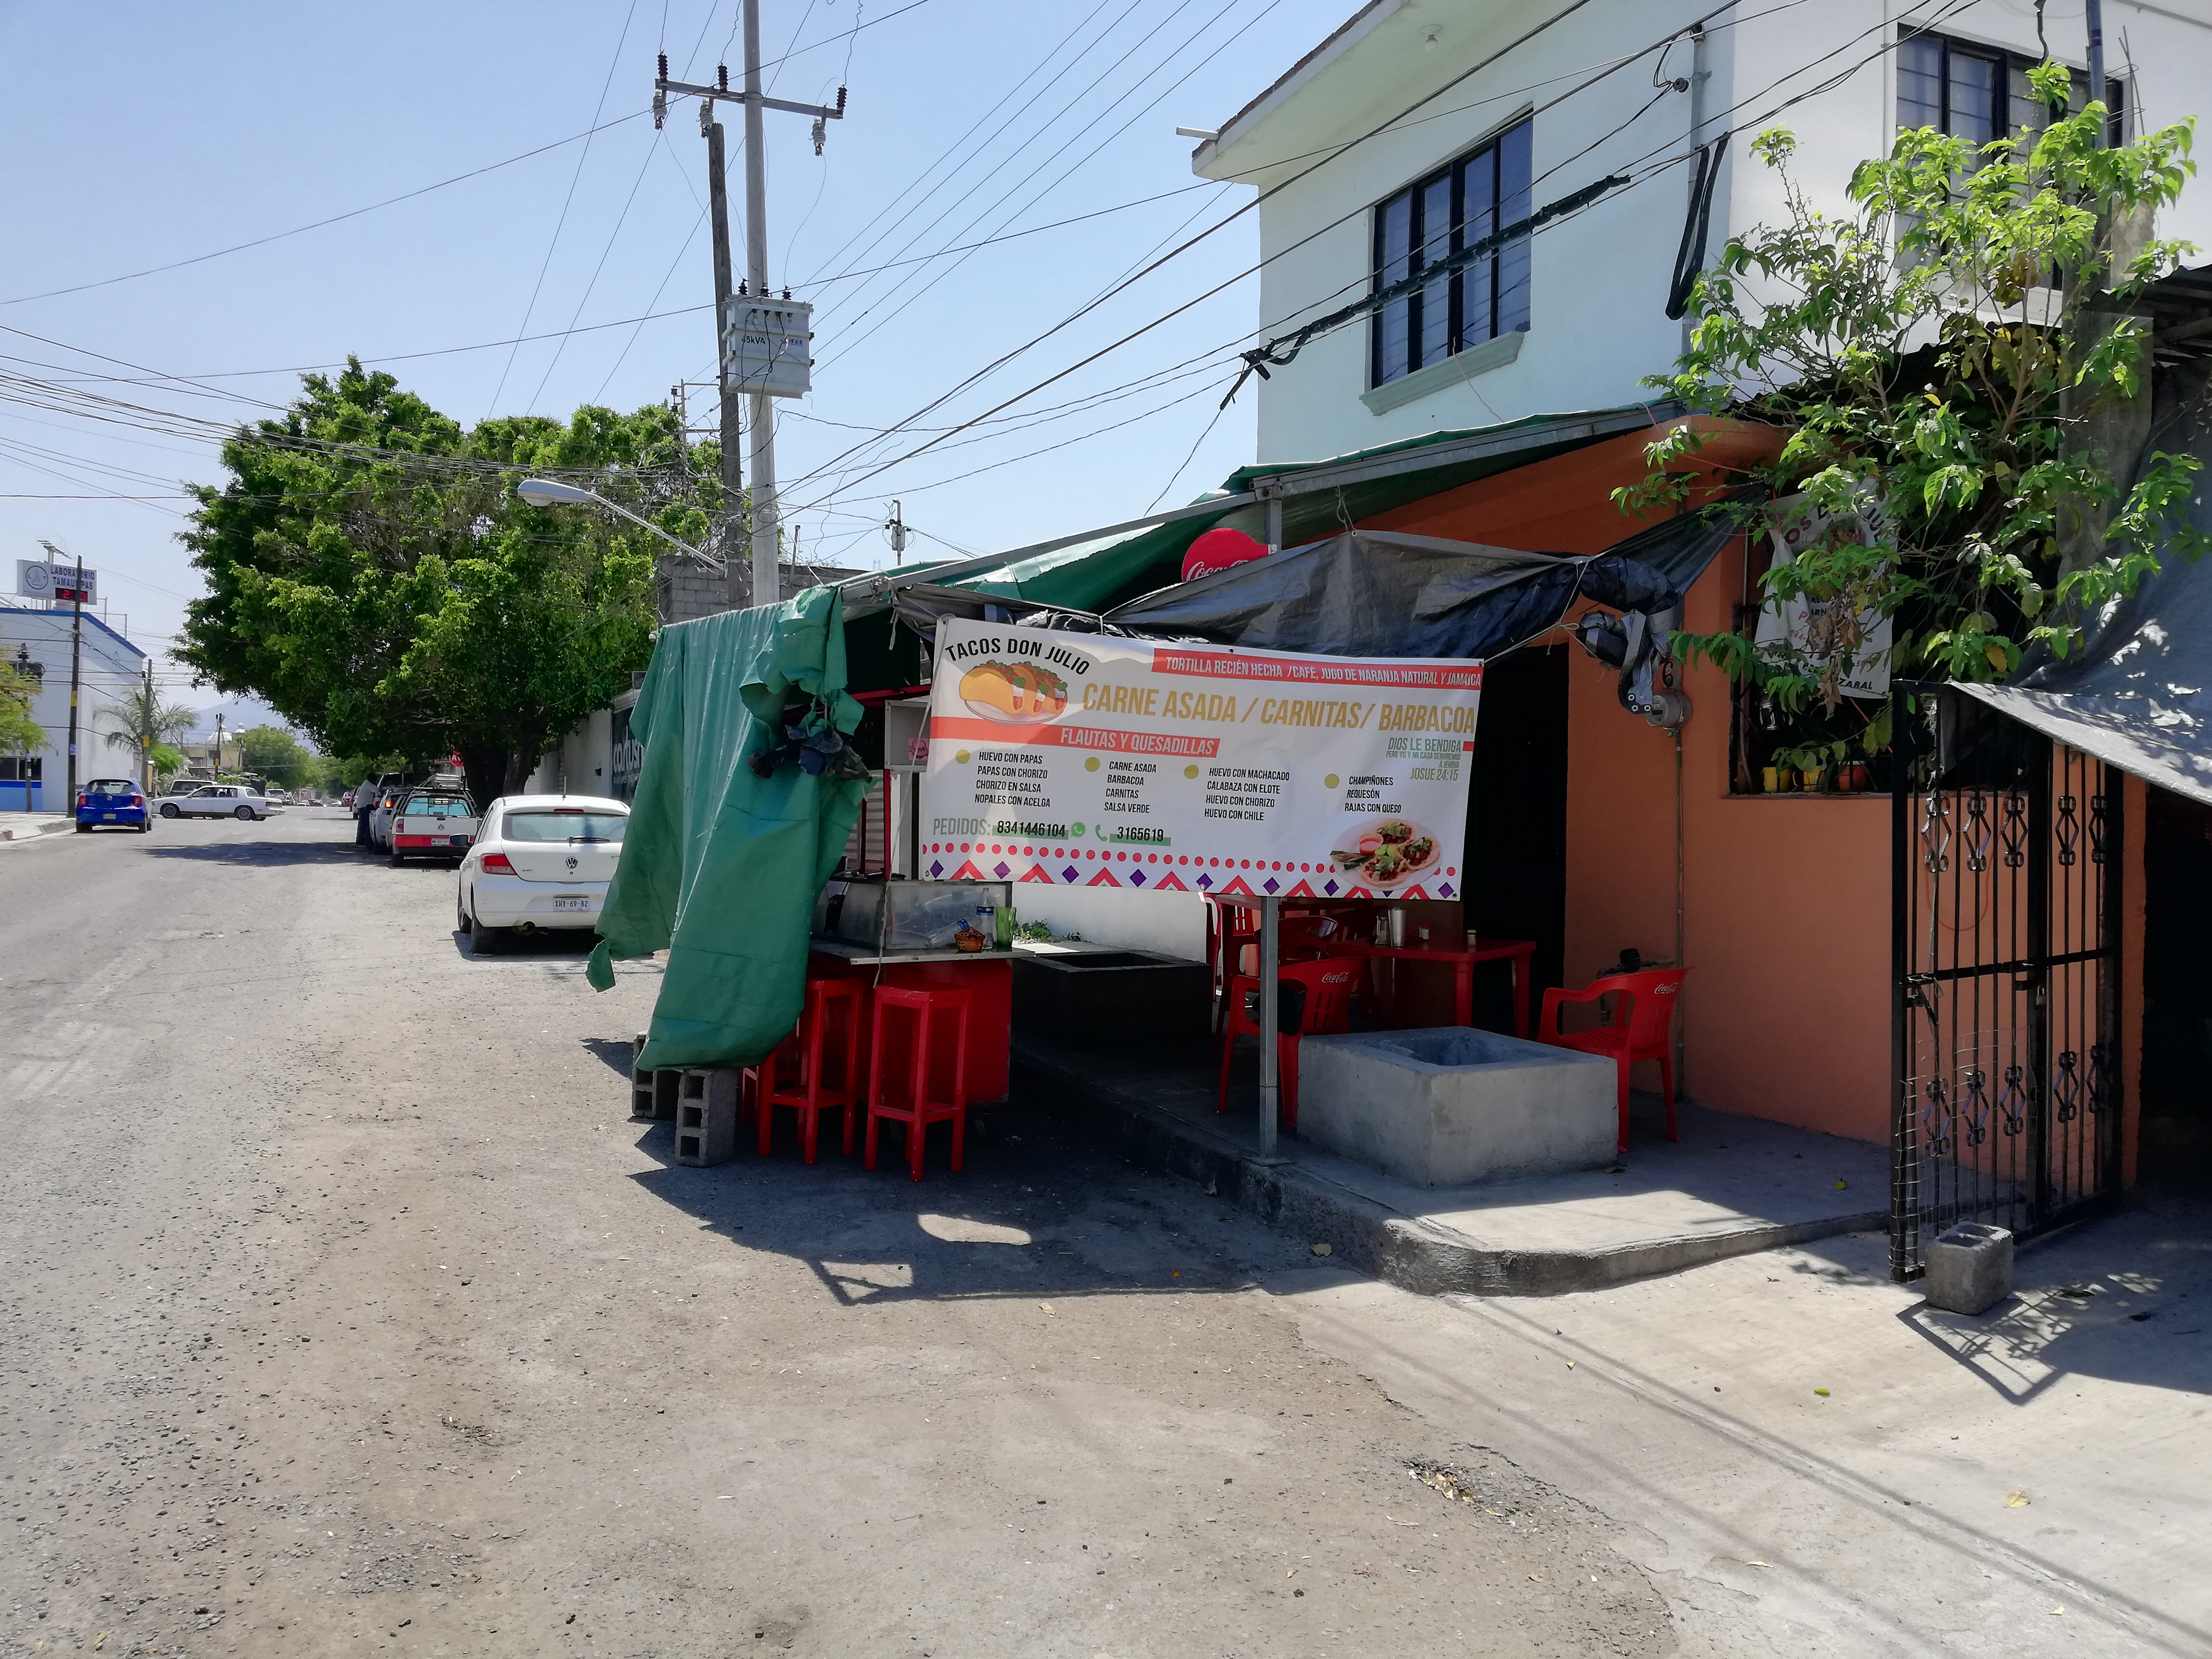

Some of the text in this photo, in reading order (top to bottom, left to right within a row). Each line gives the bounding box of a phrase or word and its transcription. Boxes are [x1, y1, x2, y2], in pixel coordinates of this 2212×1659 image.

[51, 566, 95, 580] LABORAORIO
[52, 577, 93, 590] TAMAUPAS
[945, 638, 1090, 675] TACOS DON JULIO
[1166, 656, 1212, 673] TORTILLA
[1214, 660, 1249, 675] RECIÉN
[1250, 663, 1283, 677] HECHA
[1321, 667, 1343, 680] JUGO
[1344, 668, 1357, 681] DE
[1358, 669, 1400, 683] NARANJA
[1401, 671, 1438, 685] NATURAL
[1441, 672, 1447, 685] Y
[1446, 673, 1481, 686] JAMAICA
[1083, 683, 1159, 716] CARNE
[1162, 691, 1236, 723] ASADA
[1378, 704, 1475, 734] BARBACOA
[1060, 728, 1214, 755] FLAUTAS Y QUESADILLAS
[1388, 737, 1461, 753] DIOS LE BENDIGA
[979, 752, 1043, 764] HUEVO CON PAPAS
[977, 766, 1048, 779] PAPAS CON CHORIZO
[1109, 761, 1156, 773] CARNE ASADA
[1107, 774, 1144, 786] BARBACOA
[1209, 768, 1290, 781] HUEVO CON MACHACADO
[1349, 775, 1394, 786] CHAMPIÑONES
[1410, 768, 1459, 781] JOSUE 24:15
[976, 780, 1041, 793] CHORIZO EN SALSA
[1207, 781, 1281, 794] CALABAZA CON ELOTE
[1106, 788, 1139, 799] CARNITAS
[1346, 788, 1380, 799] REQUESÓN
[975, 794, 1051, 807] NOPALES CON ACELGA
[1206, 794, 1275, 807] HUEVO CON CHORIZO
[1104, 802, 1150, 814] SALSA VERDE
[1204, 808, 1264, 821] HUEVO CON CHILE
[1345, 803, 1402, 813] RAJAS CON QUESO
[742, 816, 766, 825] 45kVA
[933, 818, 1164, 842] PEDIDOS: 8341446104 3165619
[555, 900, 589, 908] XHV-69-82
